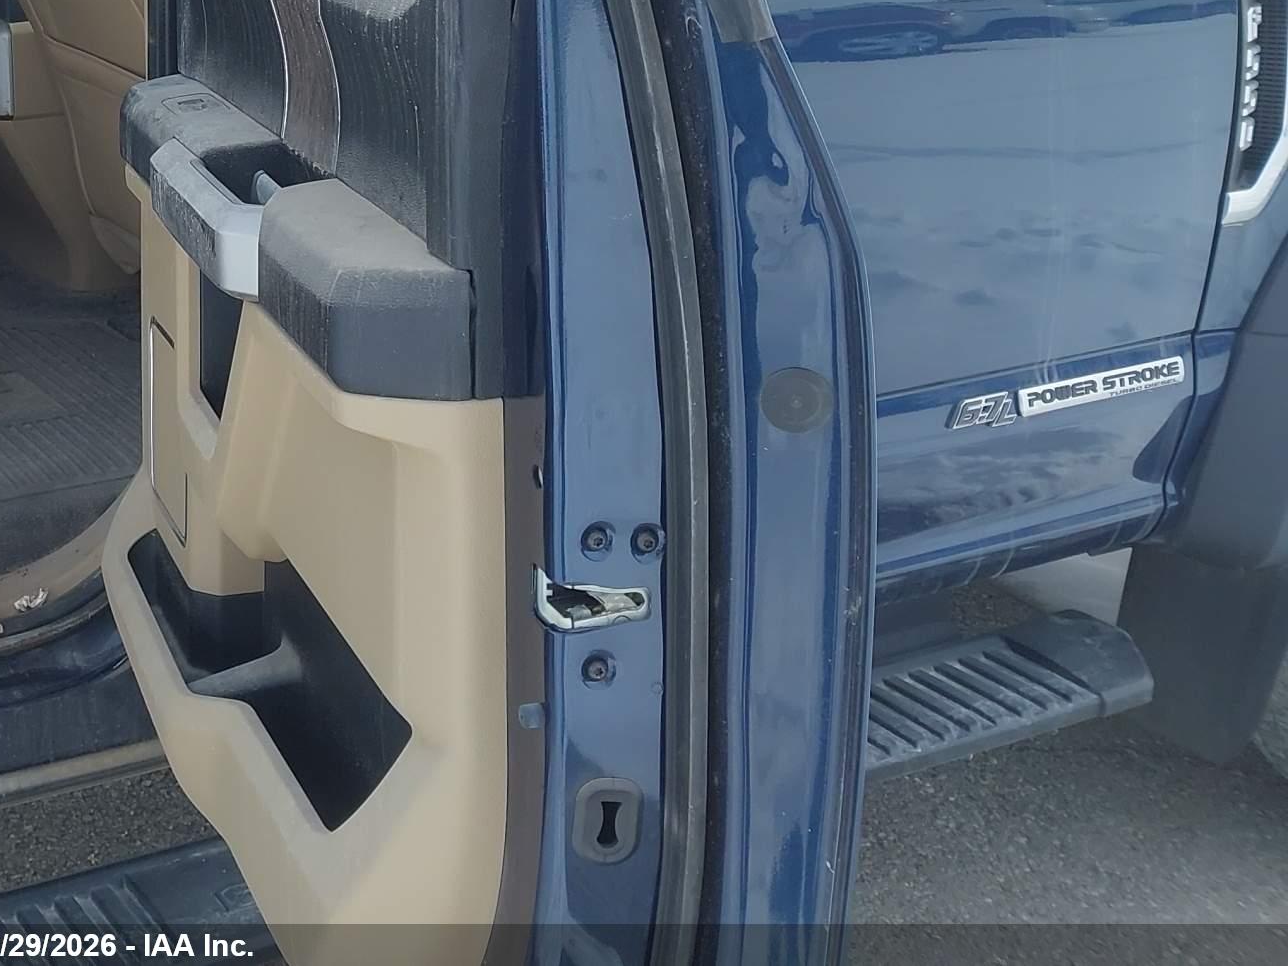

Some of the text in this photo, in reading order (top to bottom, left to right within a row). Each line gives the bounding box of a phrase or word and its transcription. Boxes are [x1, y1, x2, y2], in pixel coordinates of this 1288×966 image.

[1027, 380, 1098, 408] POWER
[1103, 361, 1180, 390] STROKE
[1109, 385, 1143, 397] TURBO
